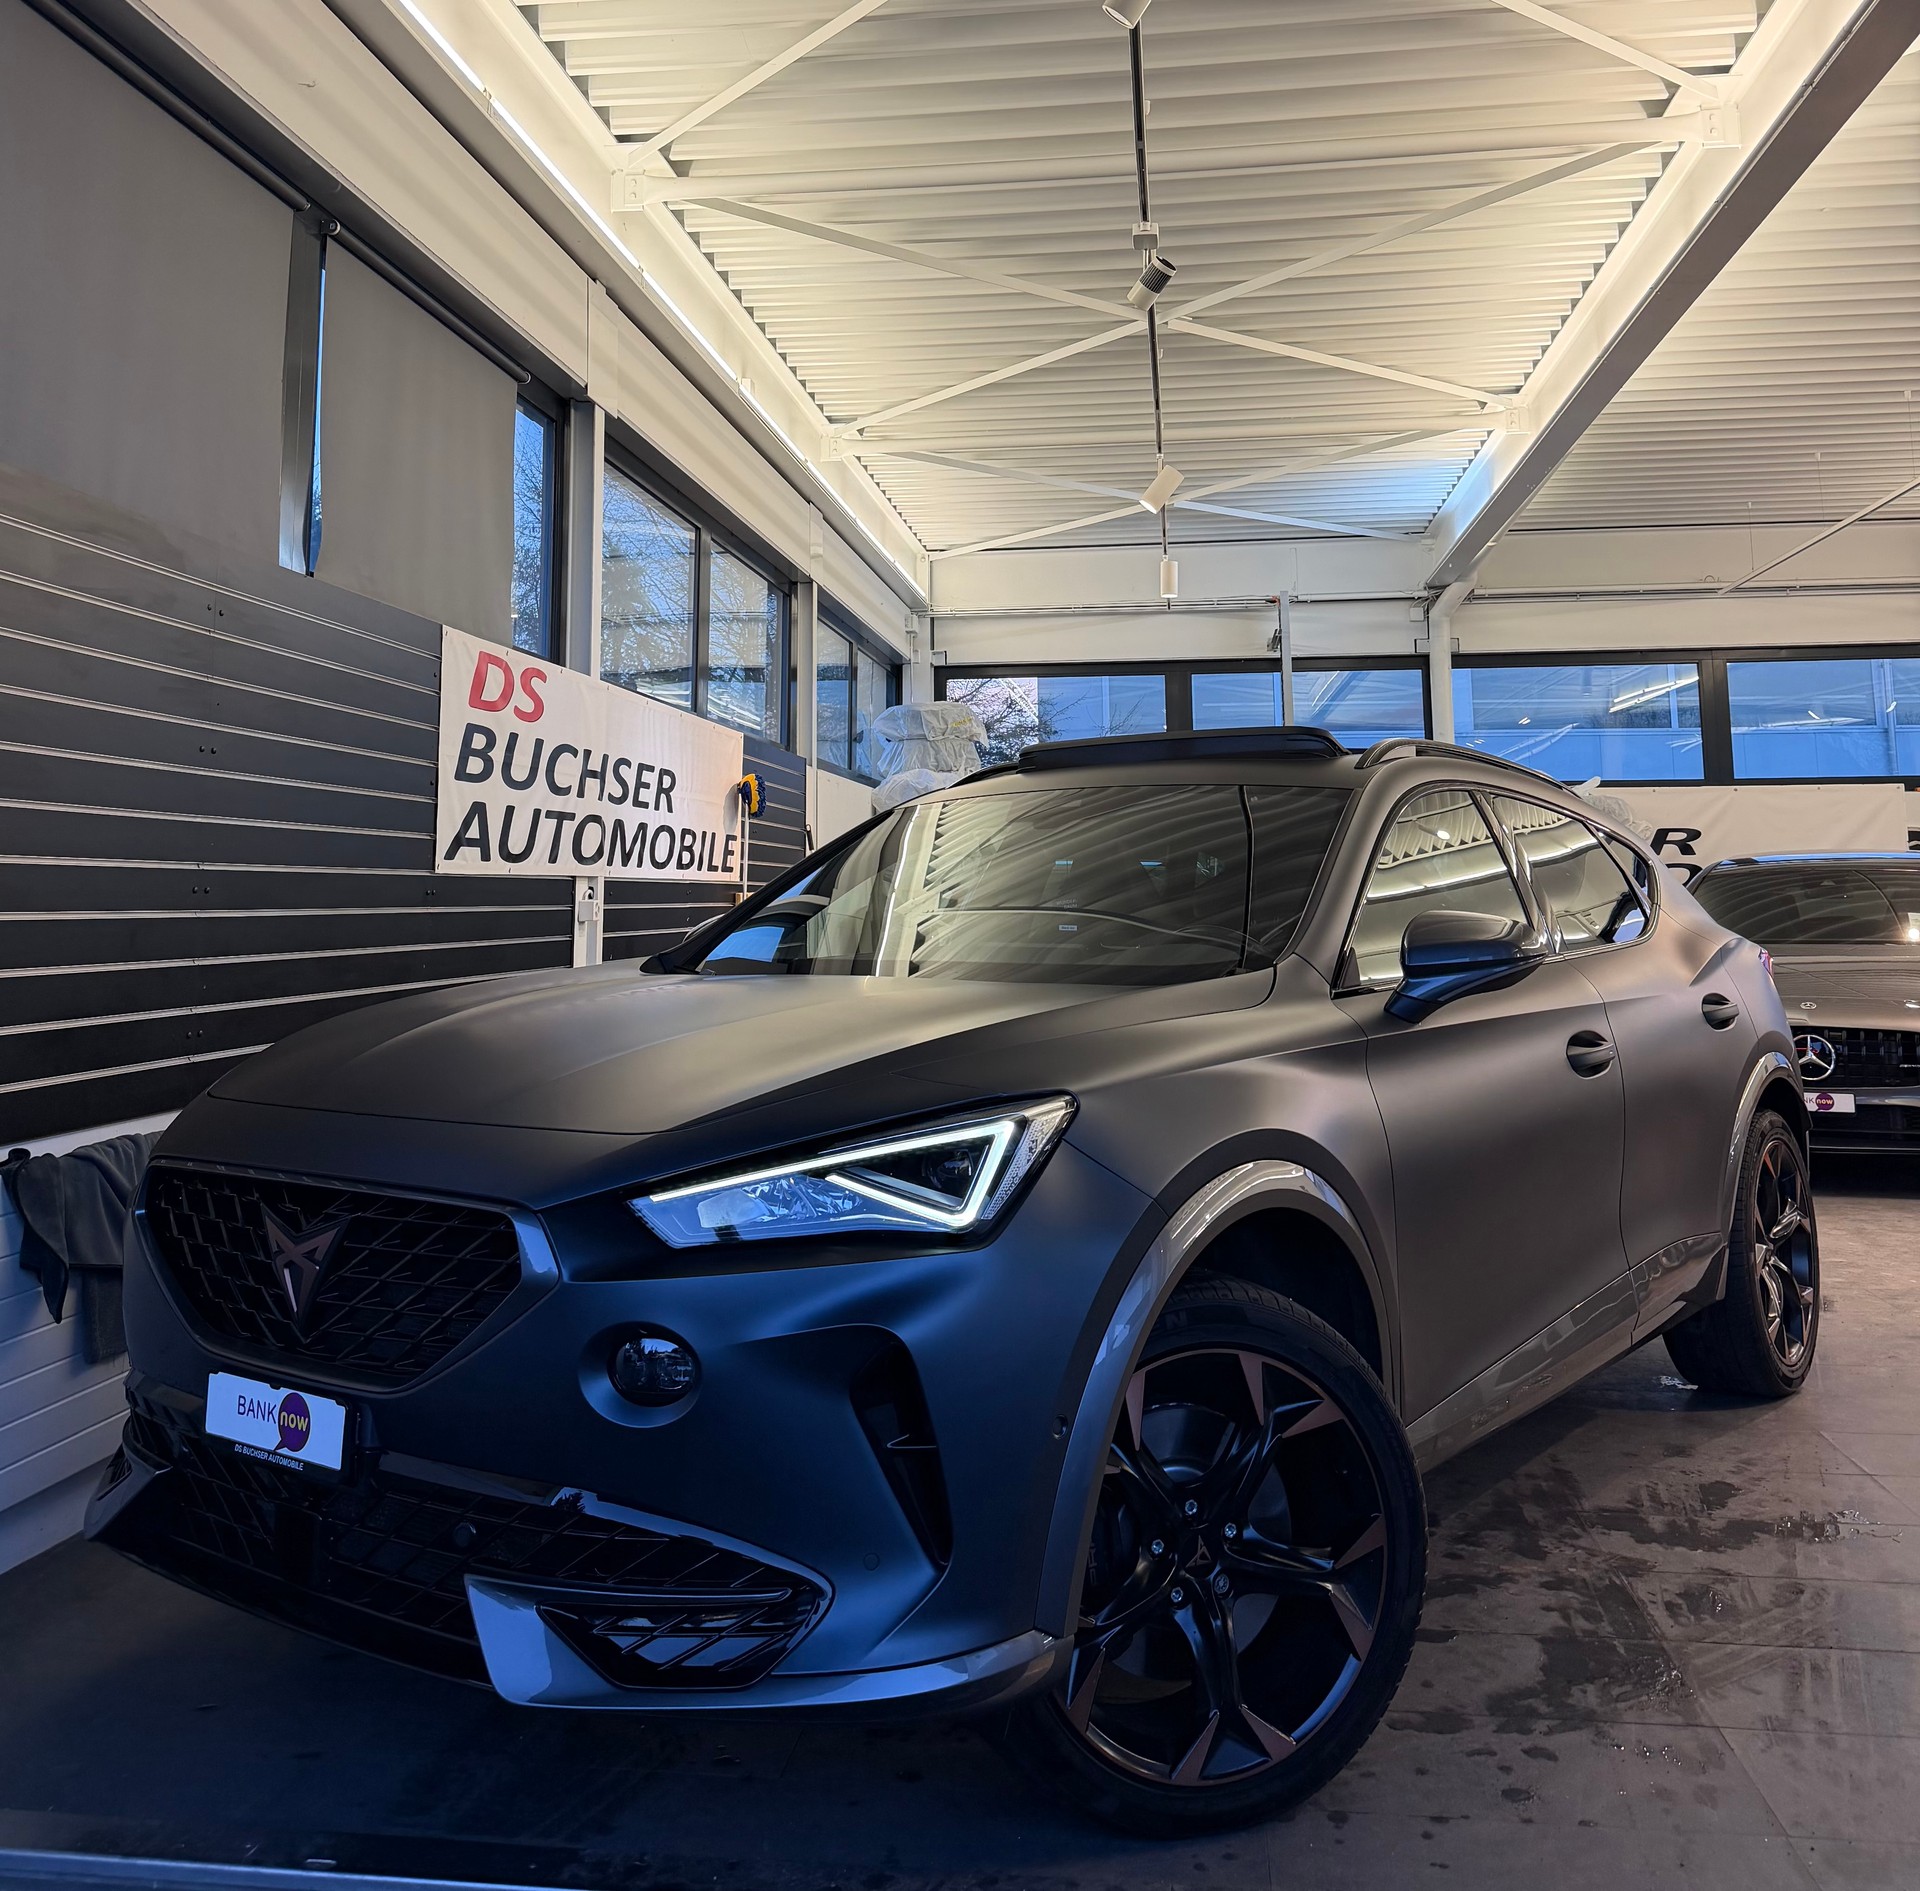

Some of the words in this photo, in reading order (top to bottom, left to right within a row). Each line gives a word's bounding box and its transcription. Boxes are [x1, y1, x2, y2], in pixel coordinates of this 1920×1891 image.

[468, 651, 547, 722] DS
[454, 723, 677, 813] BUCHSER
[444, 801, 738, 872] AUTOMOBILE
[237, 1395, 277, 1424] BANK
[280, 1411, 308, 1432] now
[234, 1444, 242, 1452] DS
[242, 1446, 268, 1460] BUCHSER
[268, 1454, 304, 1470] AUTOMOBILE
